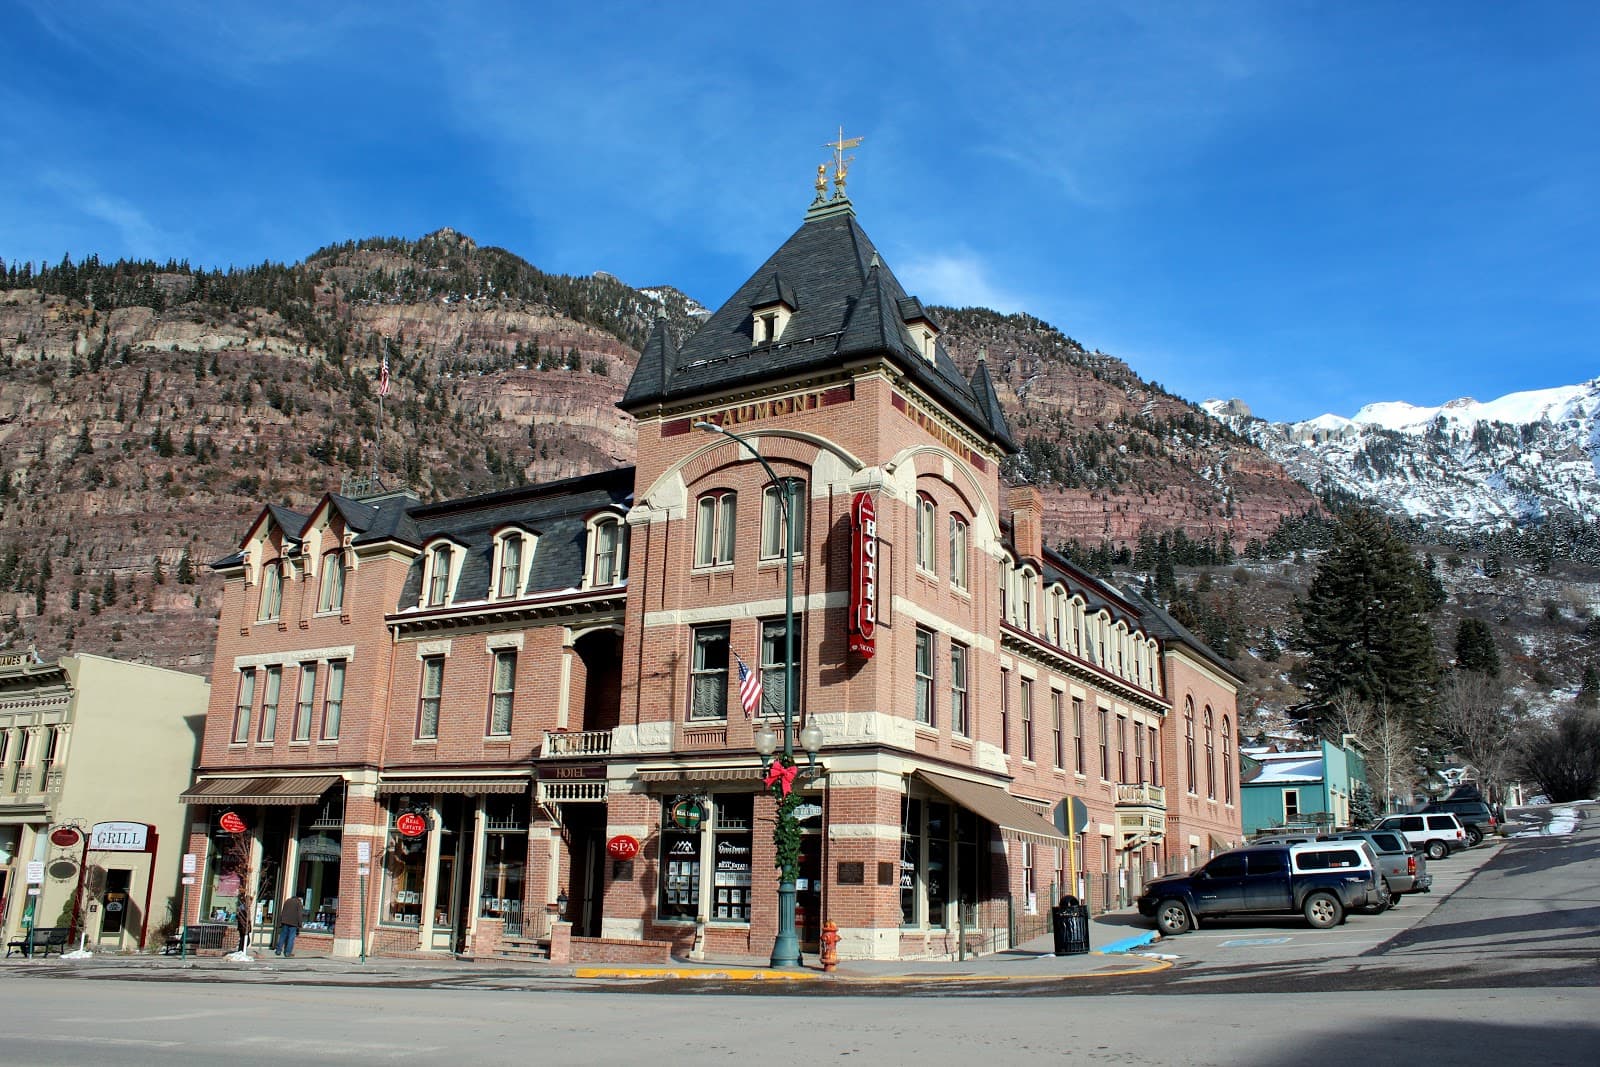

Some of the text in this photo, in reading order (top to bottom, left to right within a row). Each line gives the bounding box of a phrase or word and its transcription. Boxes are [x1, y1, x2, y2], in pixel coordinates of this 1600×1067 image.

[689, 391, 825, 433] BEAUMONT
[863, 518, 878, 623] HOTEL
[556, 767, 586, 779] HOTEL
[405, 817, 419, 825] REAL
[97, 832, 141, 845] GRILL
[610, 842, 636, 852] SPA
